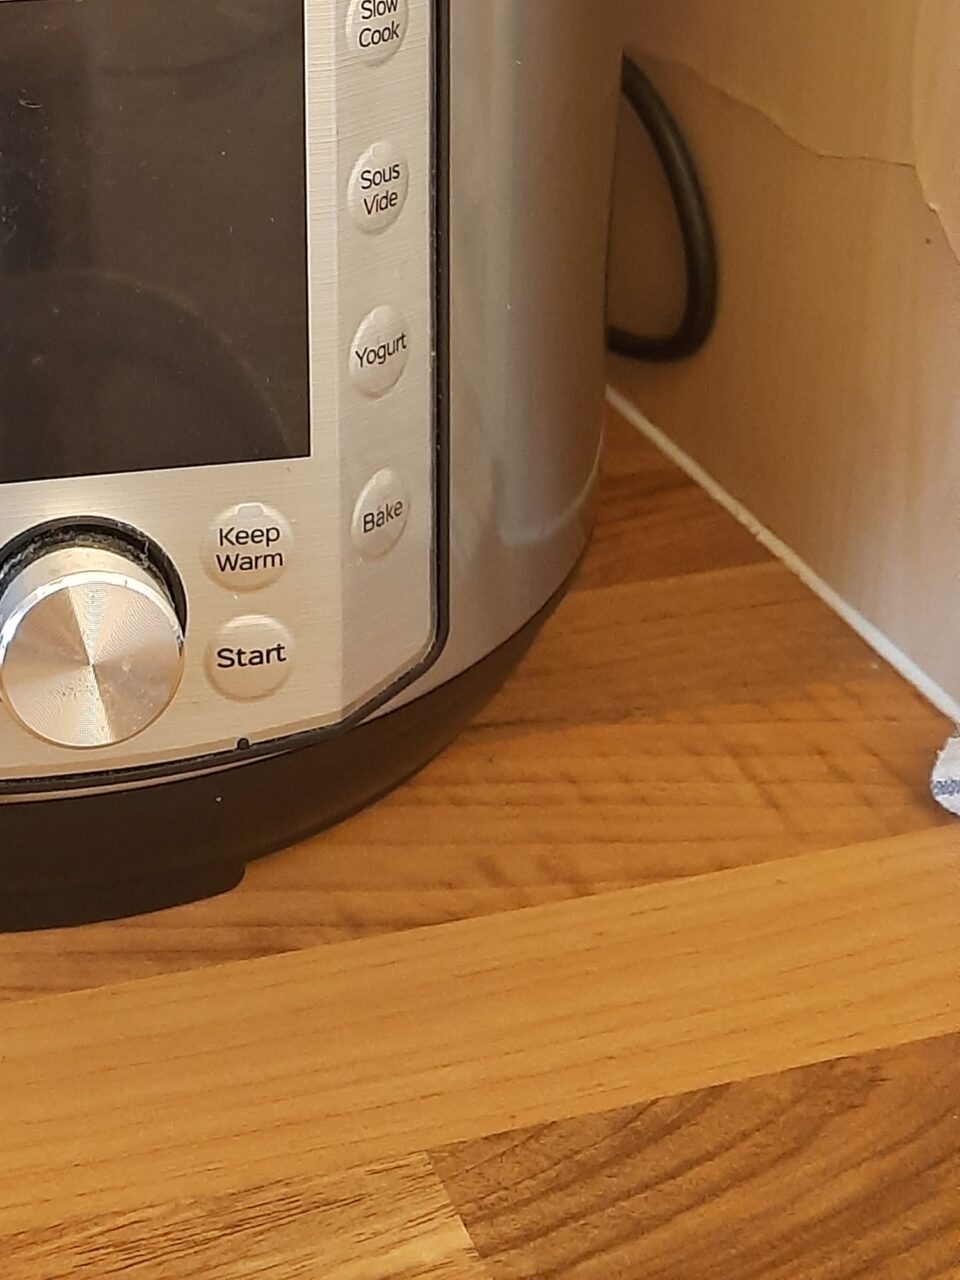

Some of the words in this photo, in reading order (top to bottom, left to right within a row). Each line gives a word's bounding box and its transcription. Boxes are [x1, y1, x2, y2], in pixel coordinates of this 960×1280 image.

[358, 20, 400, 48] Cook
[361, 164, 400, 189] Sous
[364, 192, 398, 215] Vide
[355, 333, 407, 368] Yogurt
[363, 501, 403, 533] Bake
[218, 525, 281, 547] Keep
[216, 550, 284, 573] Warm
[216, 643, 288, 669] Start
